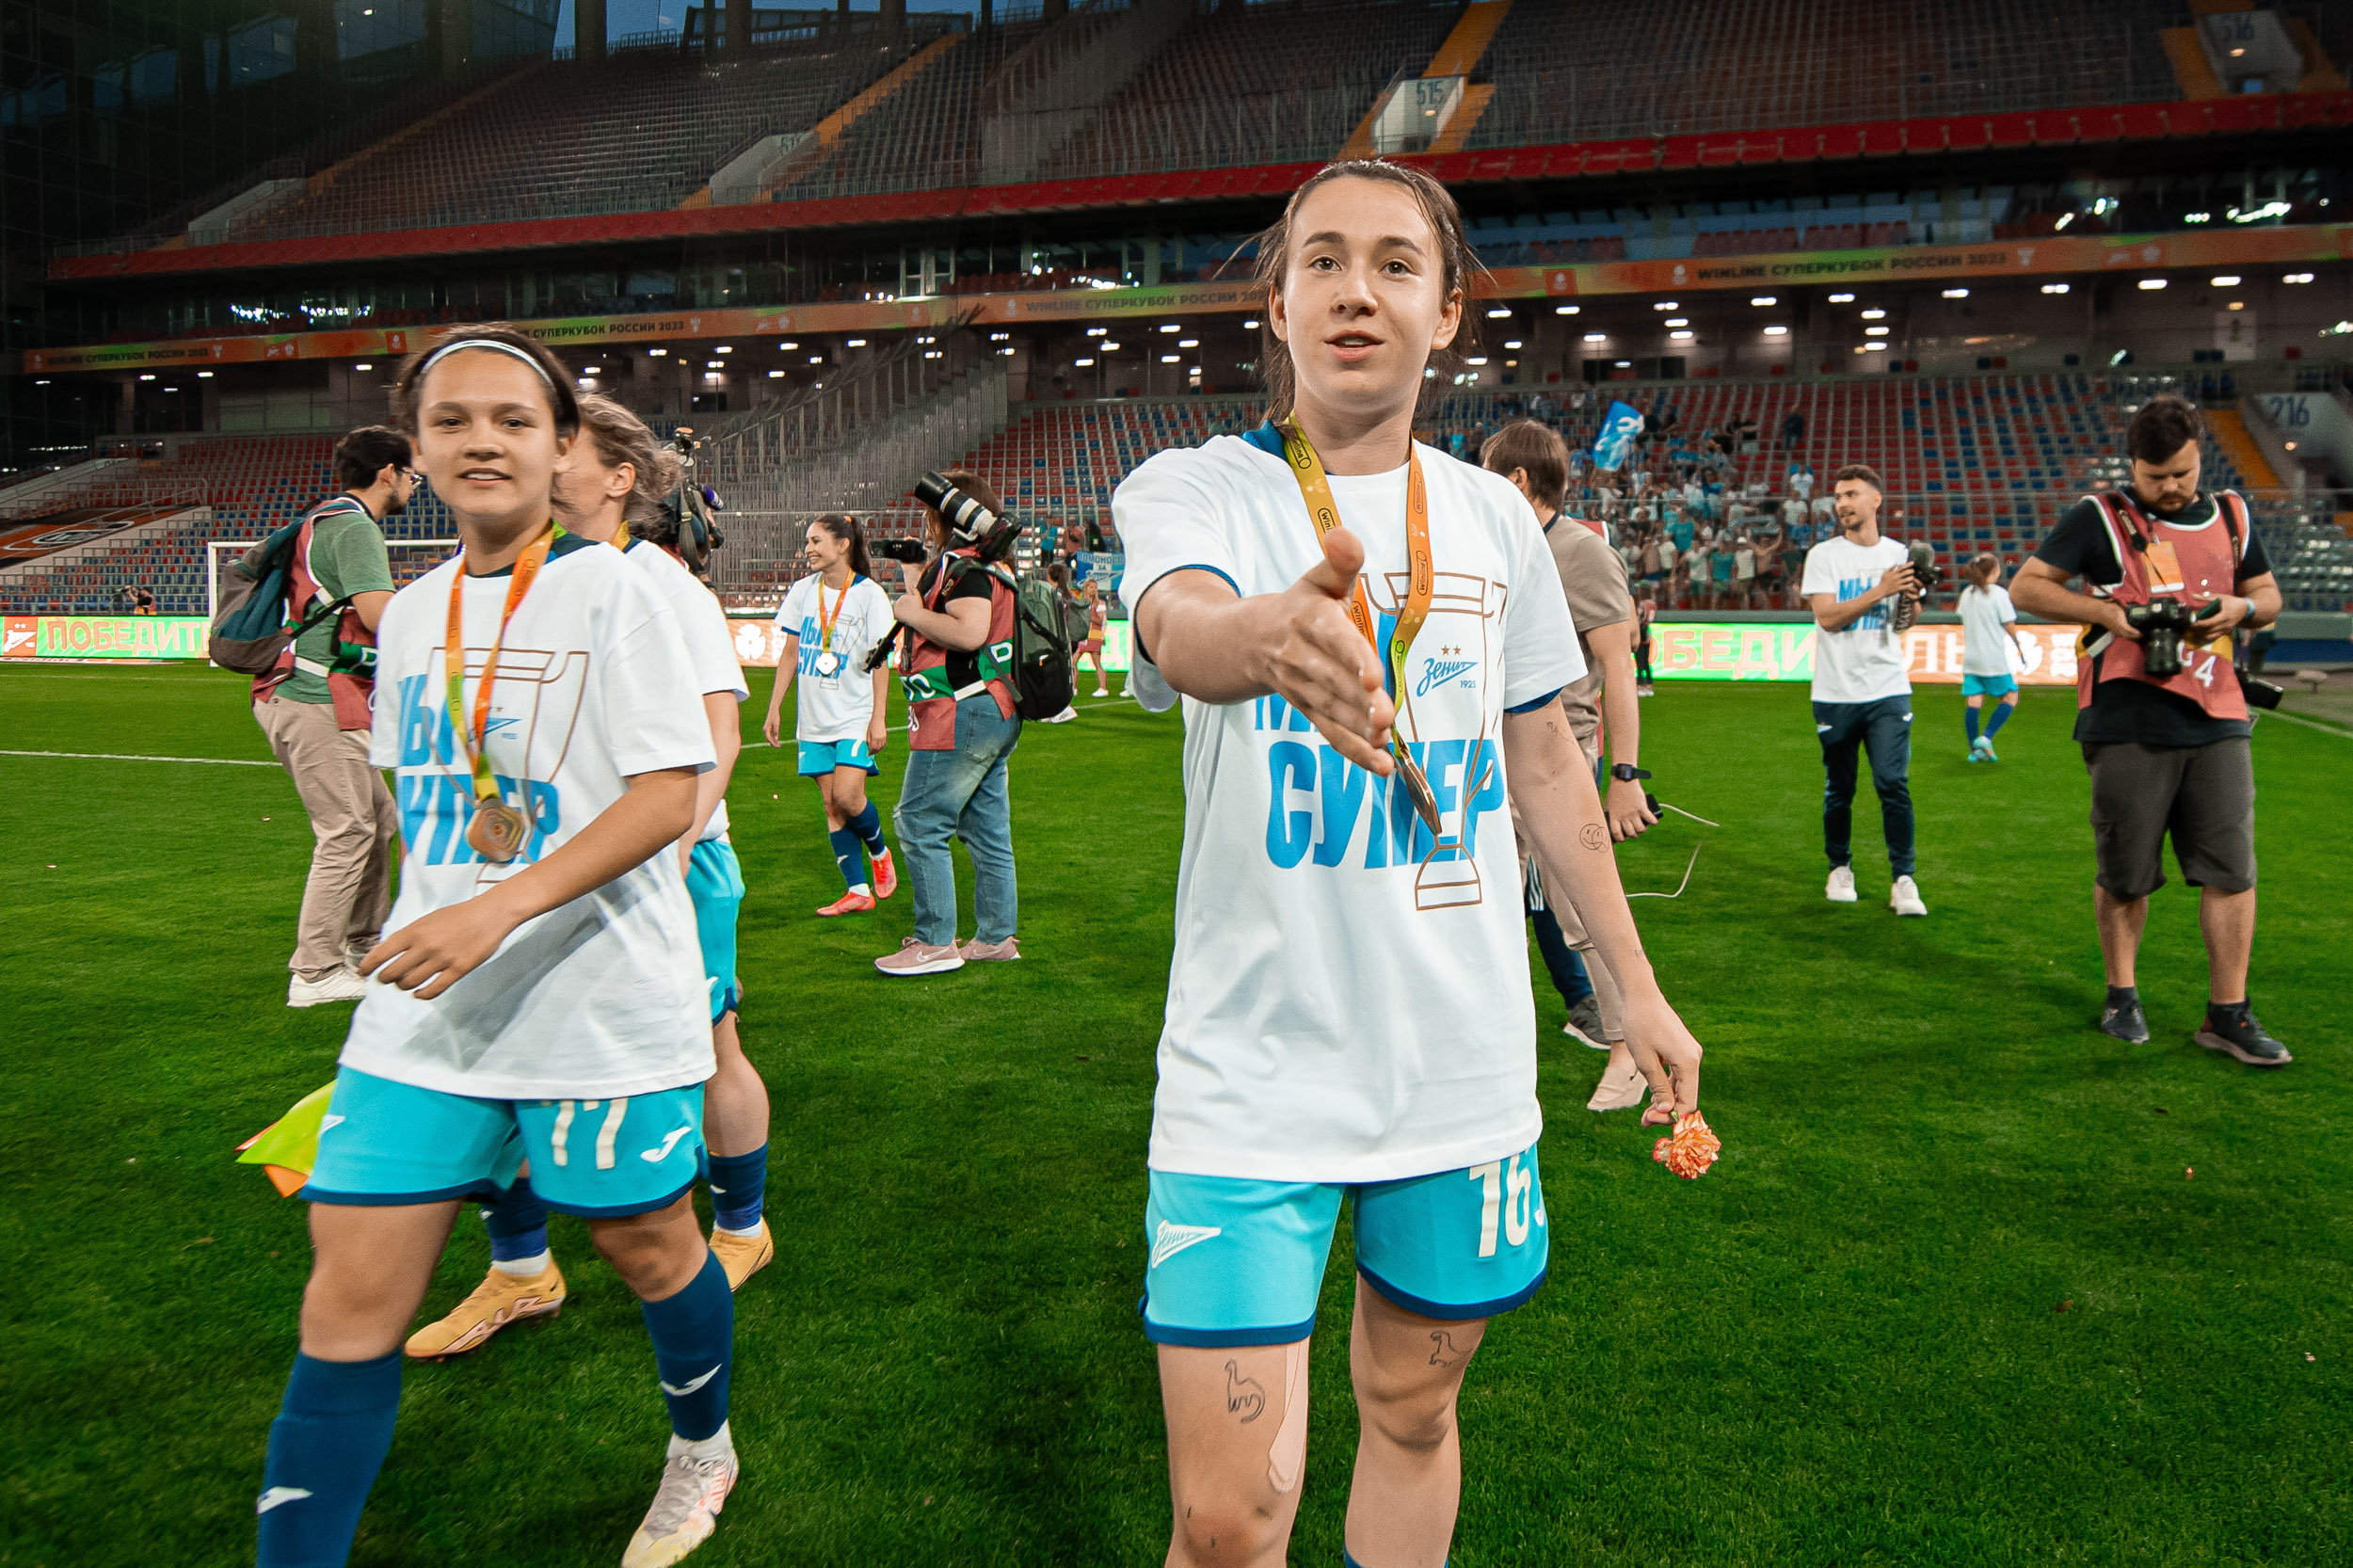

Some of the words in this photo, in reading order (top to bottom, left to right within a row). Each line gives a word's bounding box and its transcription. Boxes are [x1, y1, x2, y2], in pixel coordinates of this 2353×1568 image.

[1771, 260, 1883, 275] СУПЕРКУБОК
[1891, 255, 1962, 269] РОССИИ
[1085, 295, 1176, 311] СУПЕРКУБОК
[1179, 291, 1238, 305] РОССИИ
[534, 324, 605, 338] СУПЕРКУБОК
[609, 322, 656, 333] РОССИИ
[659, 321, 684, 331] 2023
[86, 351, 145, 363] СУПЕРКУБОК
[148, 349, 185, 360] РОССИИ
[1469, 1153, 1531, 1257] 16
